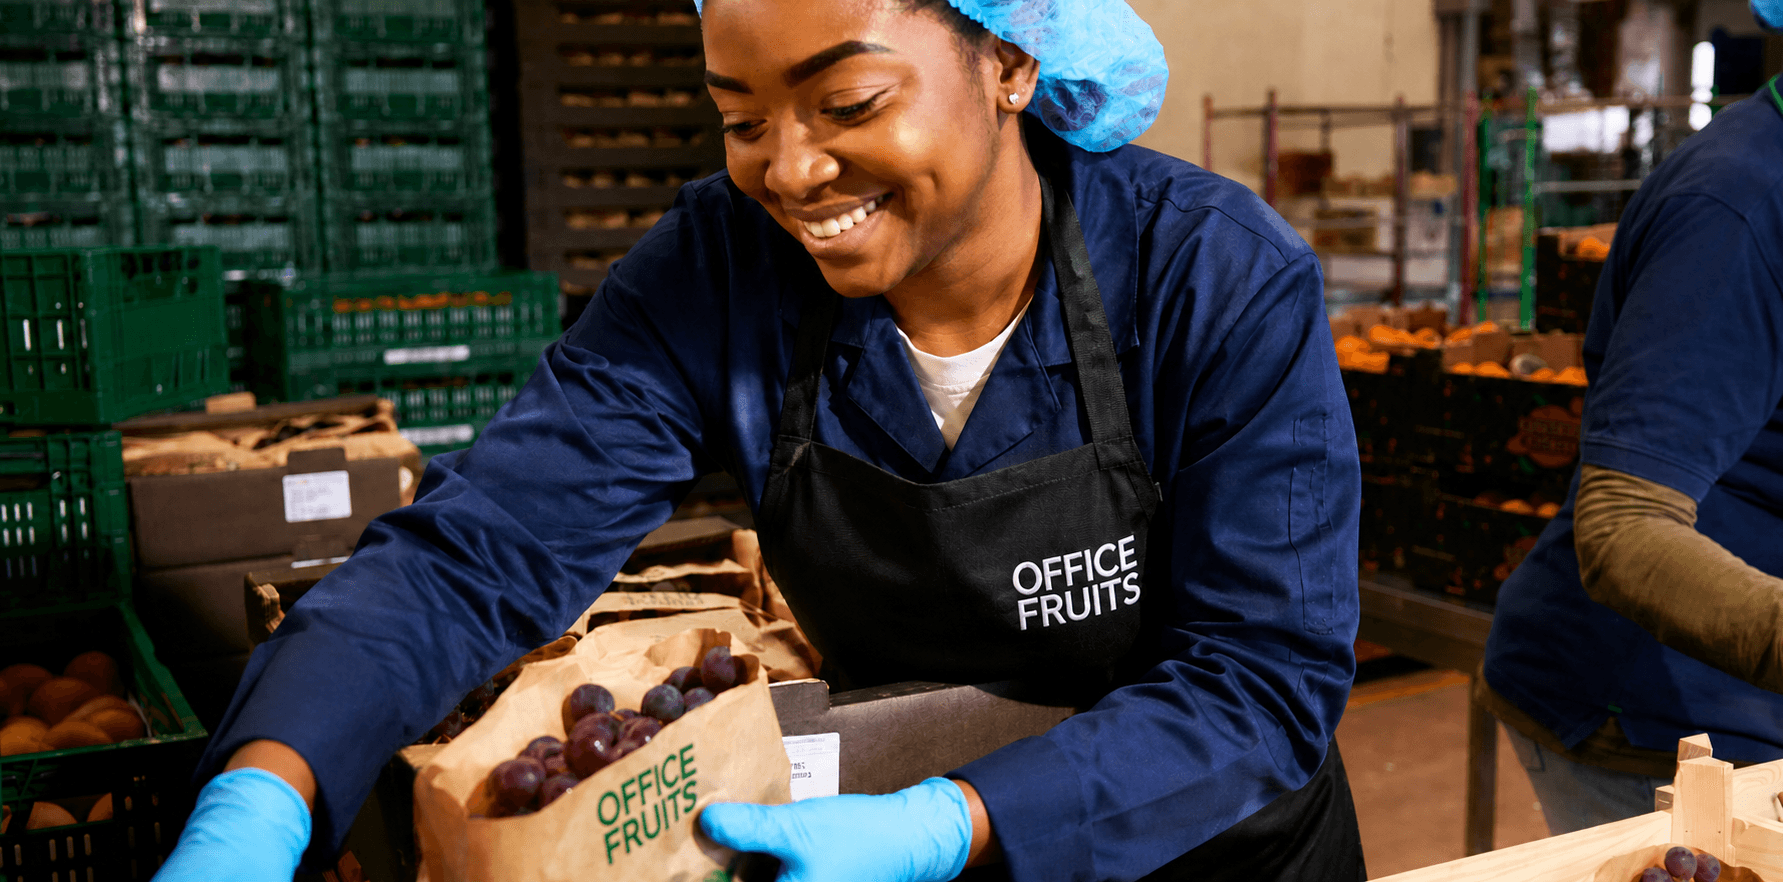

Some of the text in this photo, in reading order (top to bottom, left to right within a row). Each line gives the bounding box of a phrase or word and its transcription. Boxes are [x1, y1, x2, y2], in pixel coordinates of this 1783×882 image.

[1012, 534, 1138, 596] OFFICE
[1017, 572, 1141, 631] FRUITS
[598, 743, 697, 826] OFFICE
[604, 780, 697, 864] FRUITS
